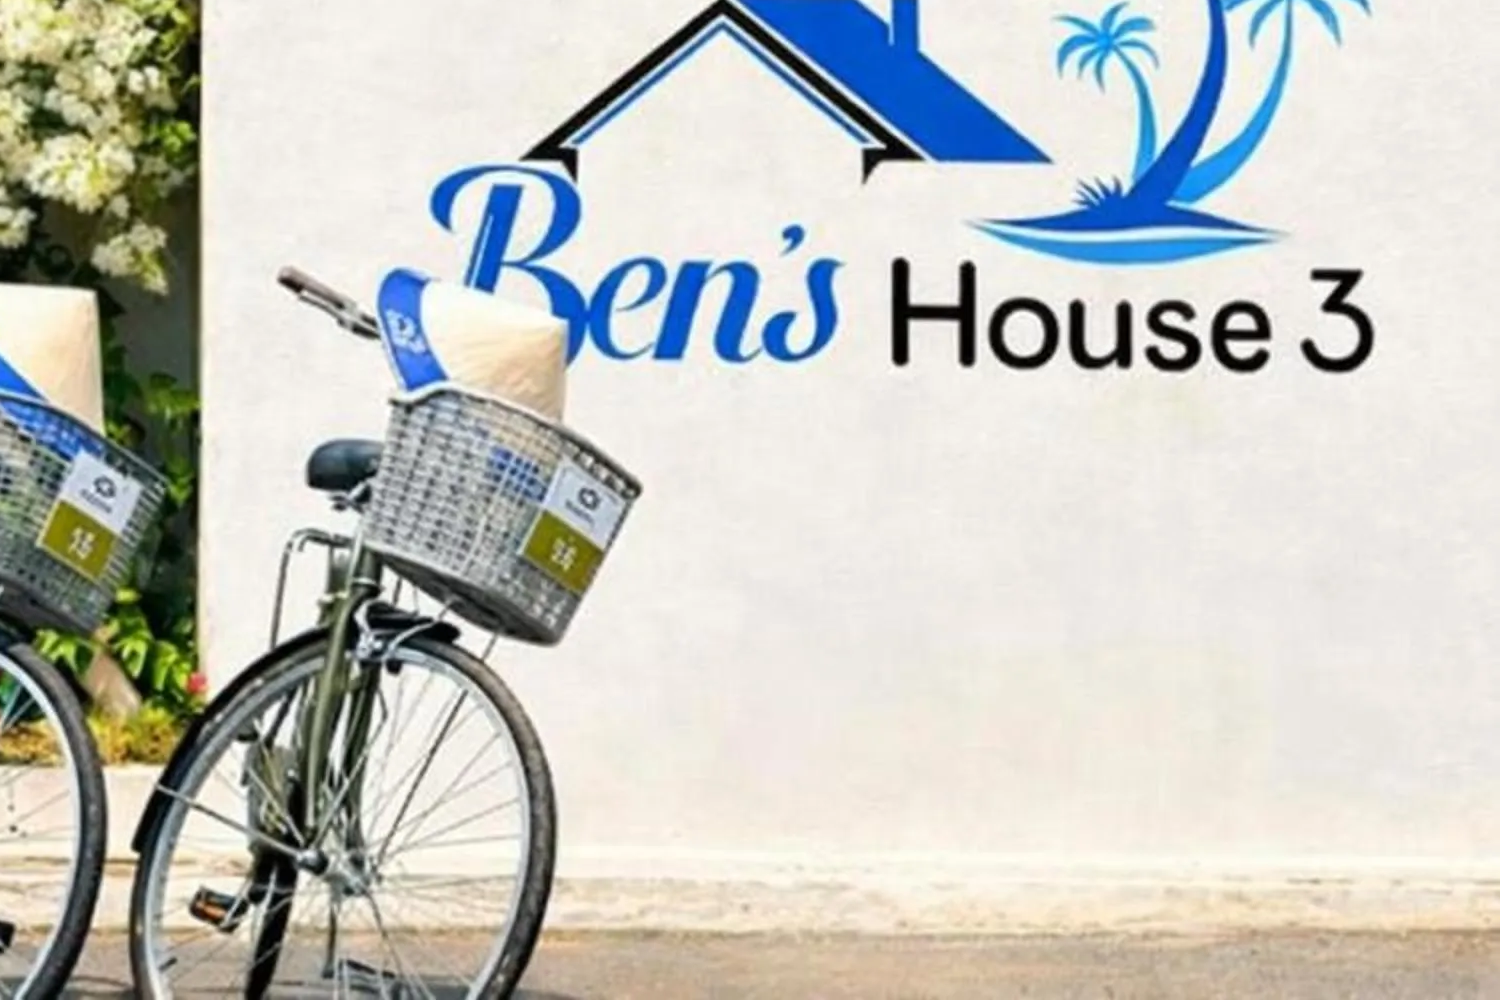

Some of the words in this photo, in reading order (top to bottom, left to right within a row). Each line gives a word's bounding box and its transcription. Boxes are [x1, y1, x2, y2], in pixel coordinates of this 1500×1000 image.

[430, 164, 845, 364] Ben's
[891, 257, 1272, 373] House
[1300, 268, 1375, 374] 3
